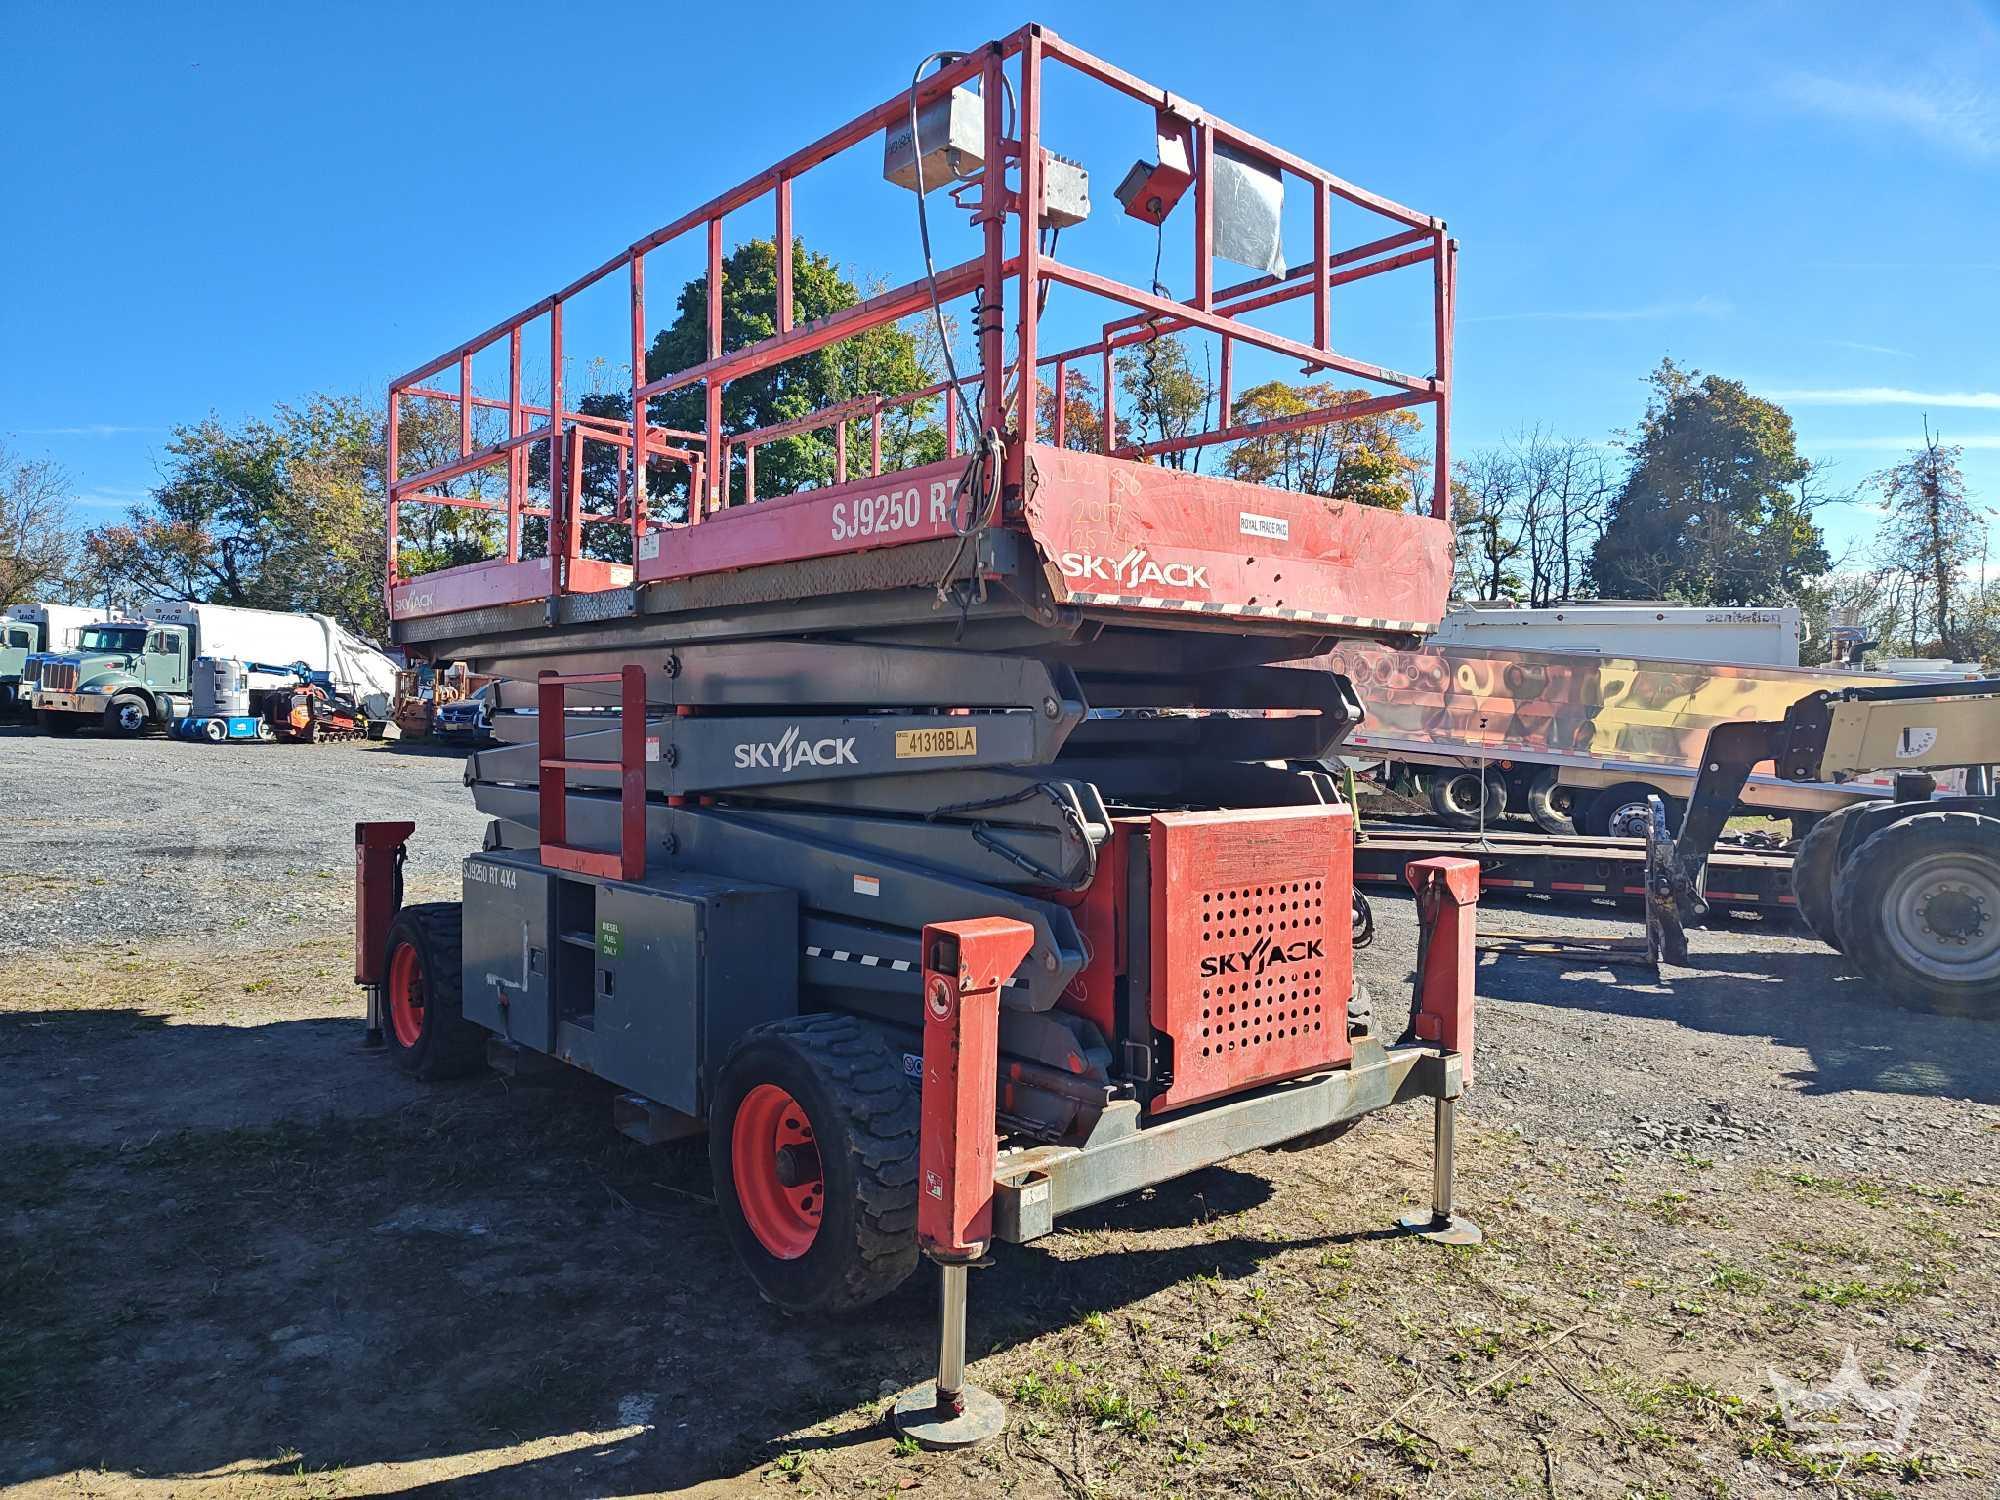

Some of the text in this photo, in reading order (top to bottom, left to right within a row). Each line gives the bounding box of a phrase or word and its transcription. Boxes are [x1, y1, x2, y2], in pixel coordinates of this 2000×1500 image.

[832, 488, 920, 541] SJ9250
[1061, 549, 1210, 589] SKYJACK
[394, 588, 433, 612] SKYJACK
[734, 725, 859, 772] SKYJACK
[463, 861, 488, 883] SJ9250
[489, 866, 499, 885] RT
[603, 934, 617, 944] FUEL
[603, 945, 617, 956] ONLY
[1200, 936, 1324, 978] SKYJACK
